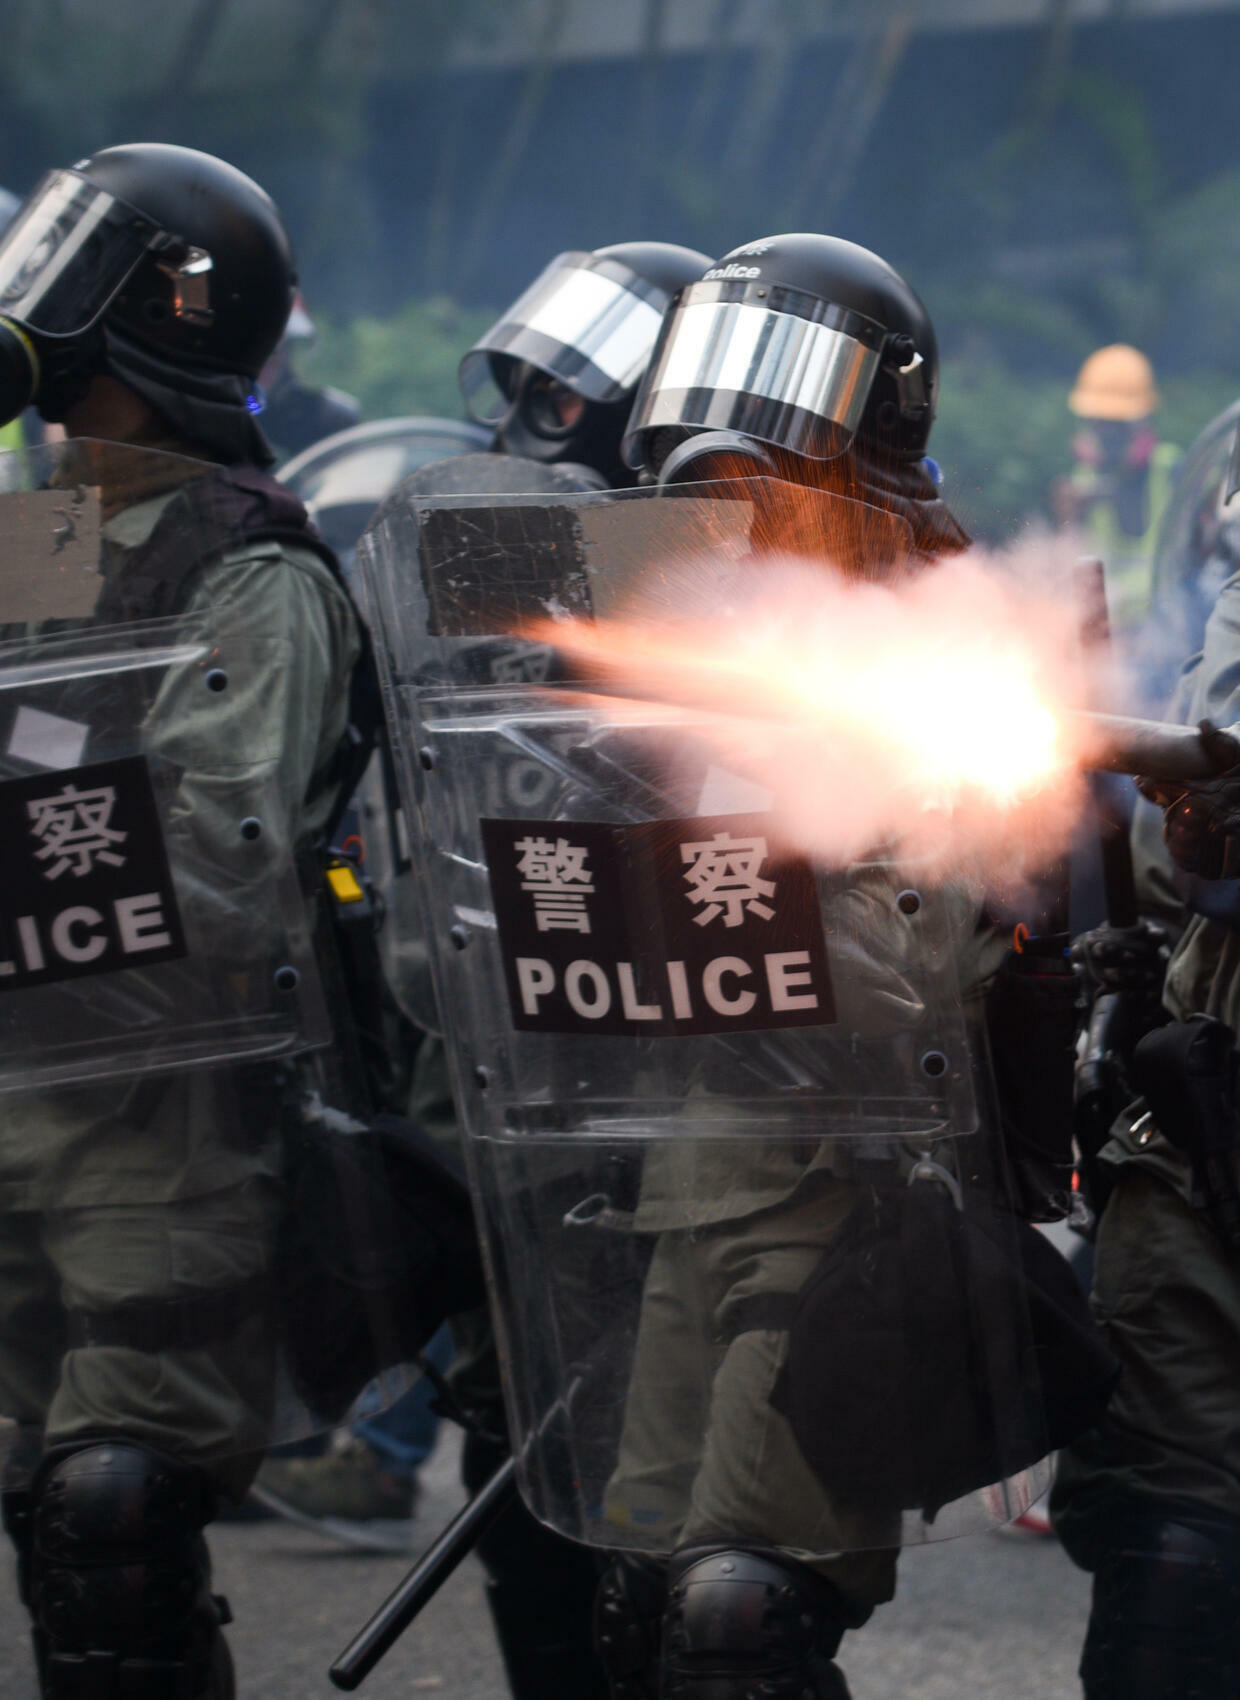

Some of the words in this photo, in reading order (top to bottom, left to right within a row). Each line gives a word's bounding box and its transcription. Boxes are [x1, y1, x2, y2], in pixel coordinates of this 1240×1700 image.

[702, 263, 761, 280] Police
[27, 784, 129, 880] 察
[514, 833, 777, 934] 警察
[516, 951, 820, 1021] POLICE
